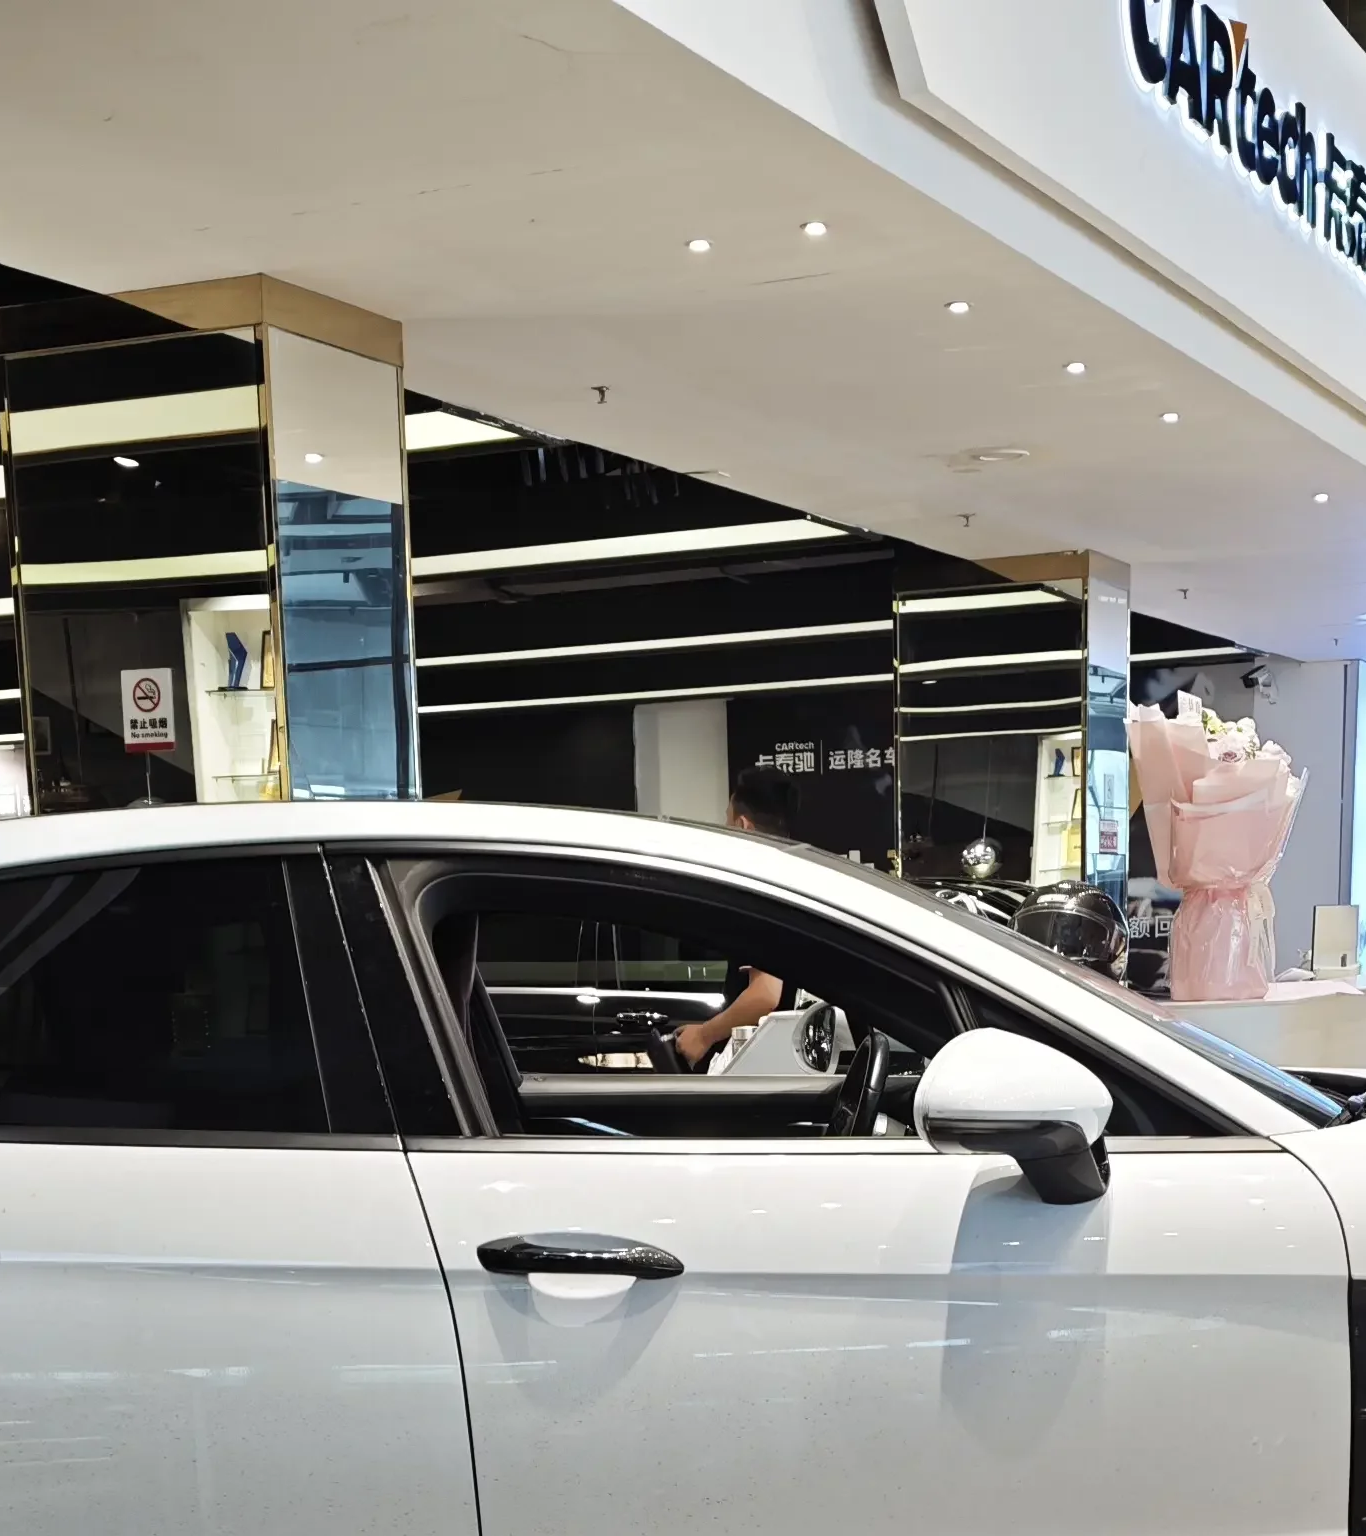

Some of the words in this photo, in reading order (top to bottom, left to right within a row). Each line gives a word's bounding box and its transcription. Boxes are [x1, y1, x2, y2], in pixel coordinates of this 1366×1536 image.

[130, 717, 168, 730] 禁止吸烟
[141, 731, 168, 739] smoking
[828, 747, 895, 770] 运隆名车
[1128, 915, 1176, 939] 额回
